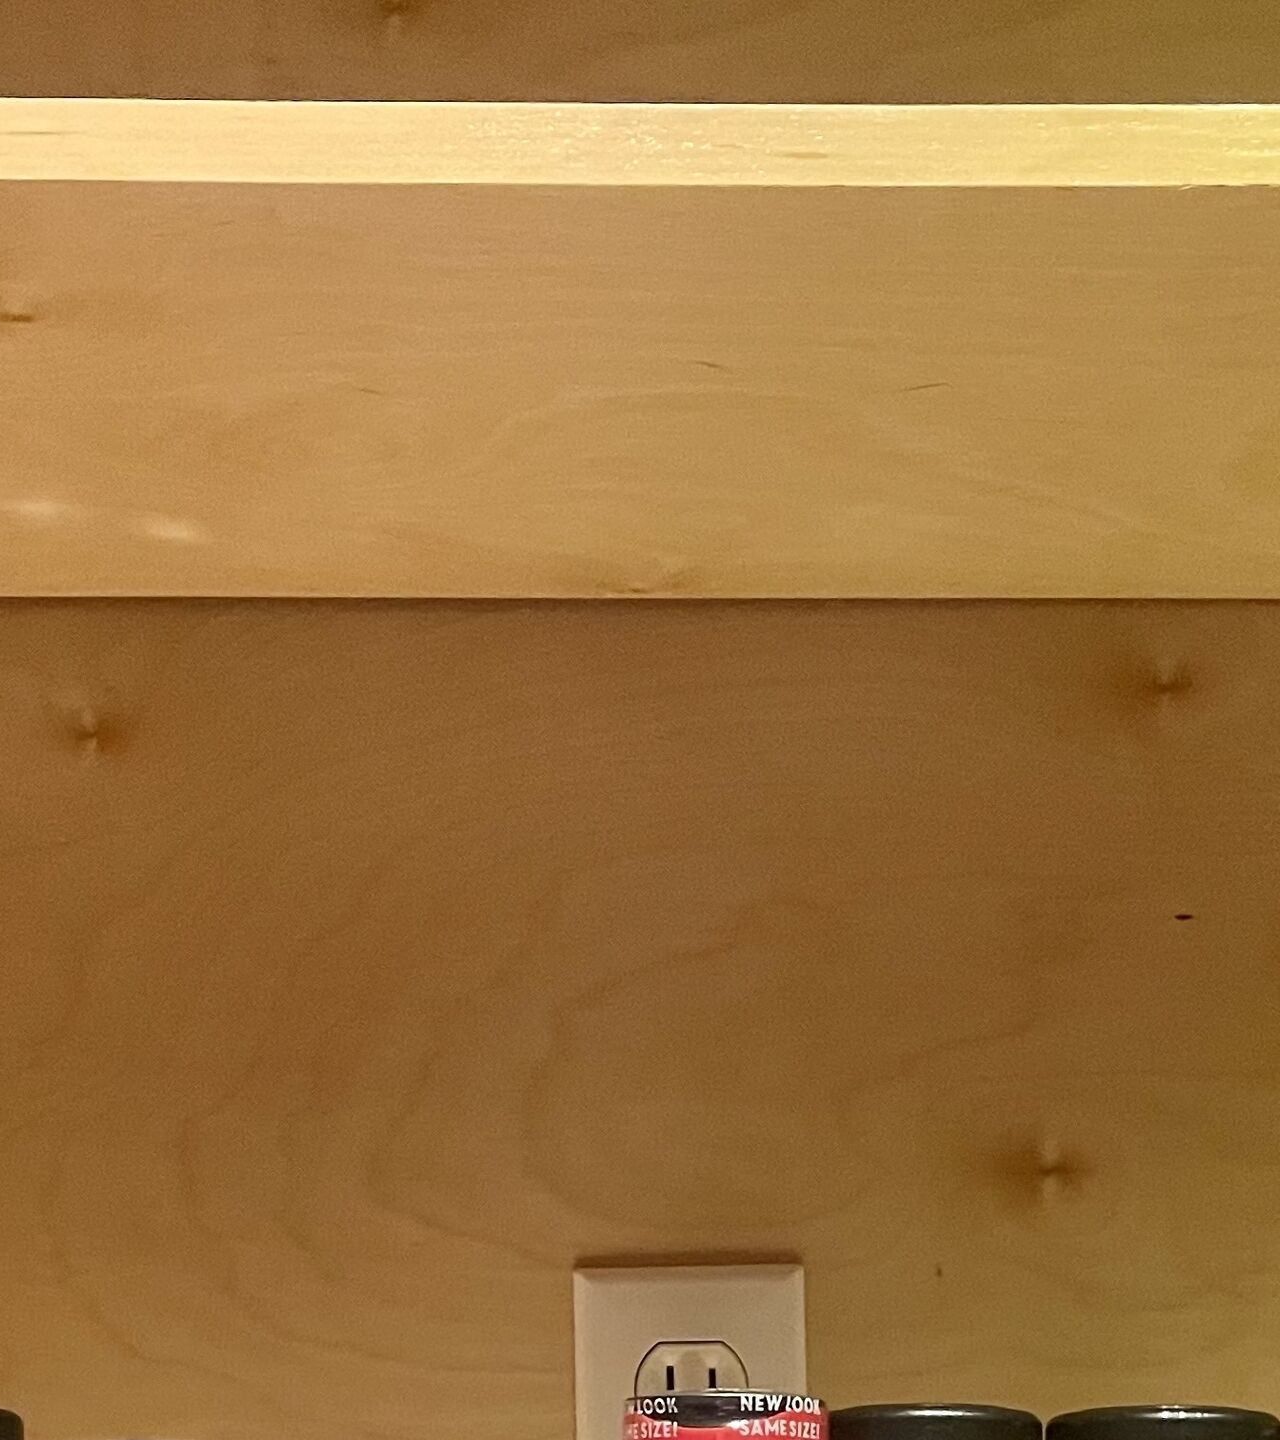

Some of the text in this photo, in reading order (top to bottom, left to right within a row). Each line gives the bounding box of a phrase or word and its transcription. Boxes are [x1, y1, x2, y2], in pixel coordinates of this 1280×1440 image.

[637, 1397, 678, 1415] LOOK
[740, 1395, 821, 1415] NEW LOOK
[641, 1421, 678, 1439] SIZE!
[739, 1419, 820, 1439] SAME SIZE!
